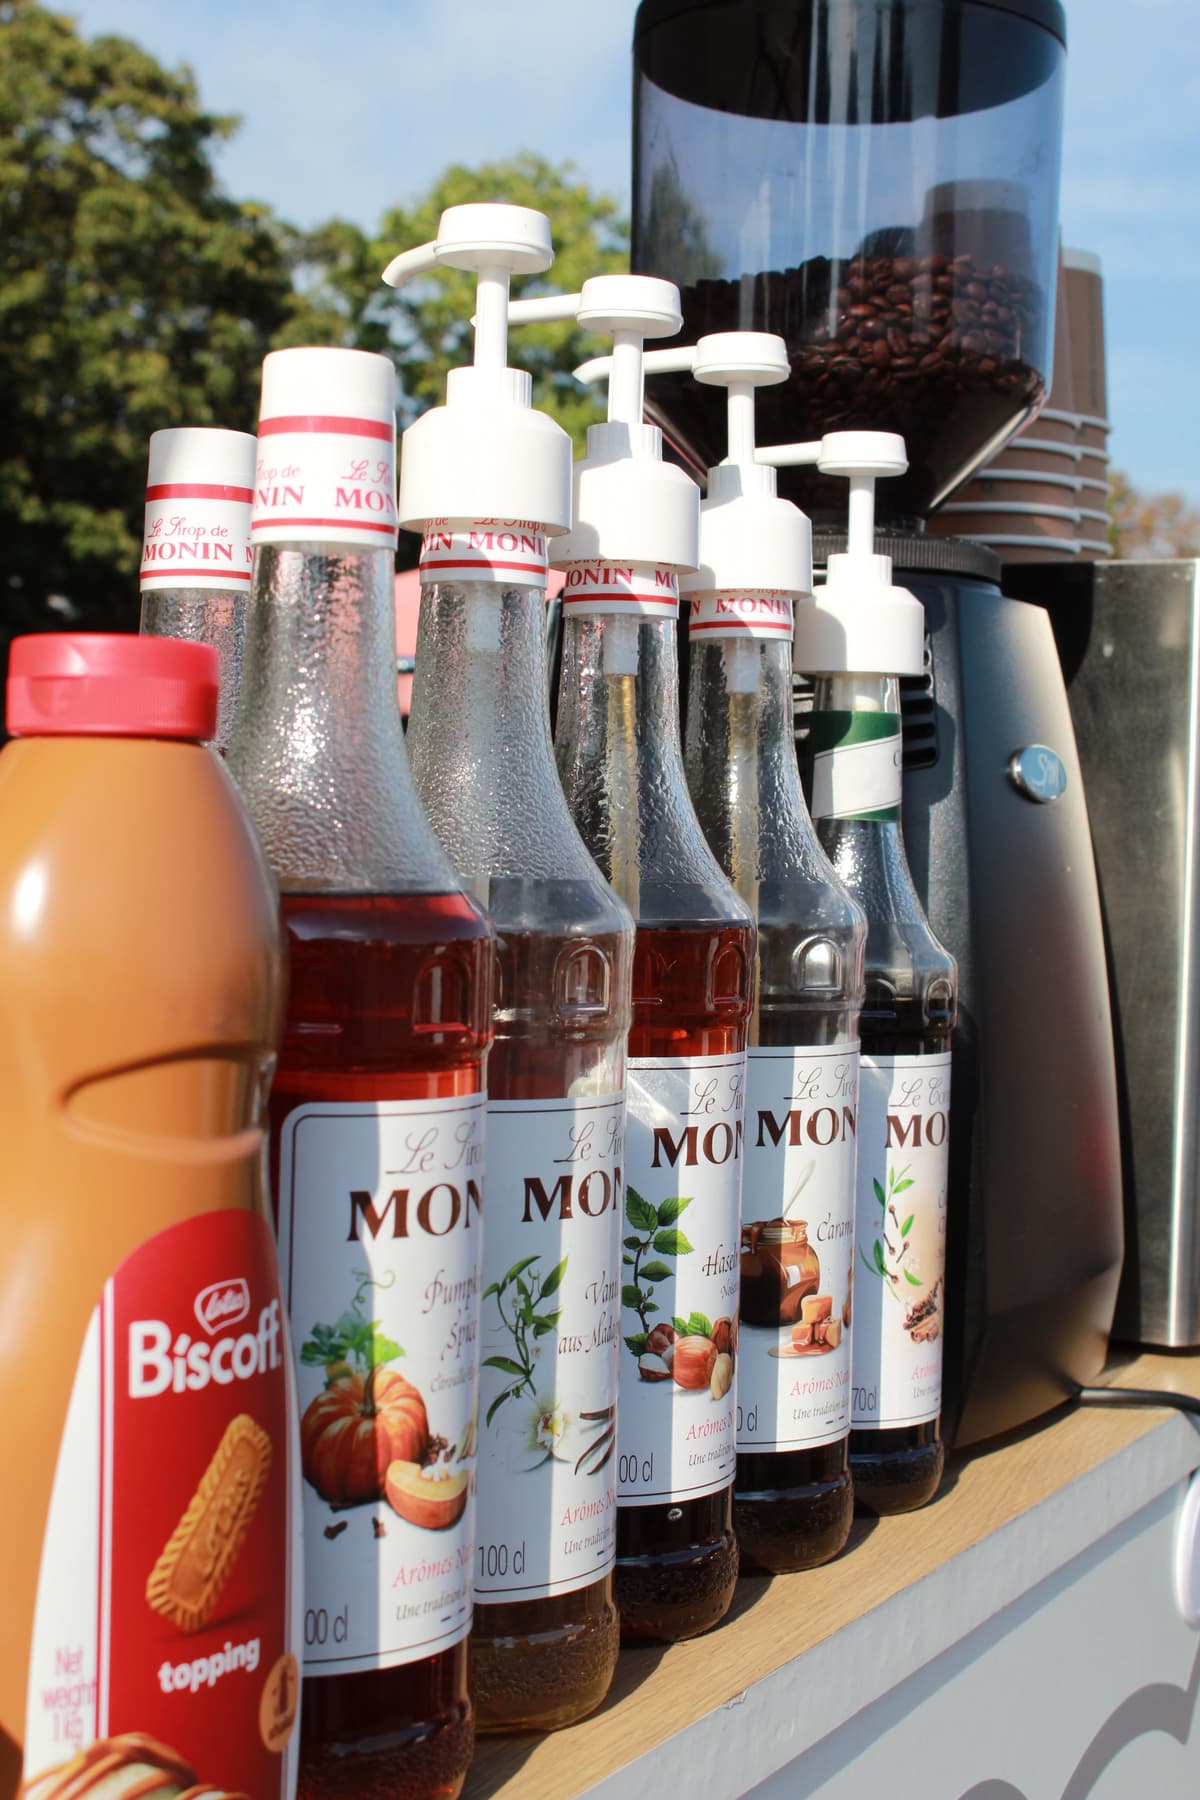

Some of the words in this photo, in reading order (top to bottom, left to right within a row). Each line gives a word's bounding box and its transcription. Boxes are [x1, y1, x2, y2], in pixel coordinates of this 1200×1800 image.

[341, 459, 369, 481] Le
[147, 518, 163, 538] Le
[165, 517, 206, 541] Sirop
[211, 525, 228, 537] de
[144, 542, 233, 562] MONIN
[680, 1078, 718, 1115] Le
[783, 1067, 822, 1100] Le
[889, 1078, 922, 1107] Le
[384, 1127, 439, 1174] Le
[552, 1121, 594, 1163] Le
[129, 1299, 280, 1399] Biscoff
[559, 1335, 583, 1354] aus
[789, 1376, 834, 1396] Arômes
[684, 1417, 727, 1440] Arômes
[747, 1404, 757, 1432] cl
[793, 1408, 812, 1421] Une
[642, 1452, 653, 1482] cl
[688, 1454, 706, 1466] Une
[560, 1498, 605, 1527] Arômes
[478, 1544, 508, 1577] 100
[513, 1540, 525, 1575] cl
[564, 1540, 583, 1555] Une
[391, 1556, 452, 1588] Arômes
[333, 1603, 348, 1644] cl
[395, 1603, 421, 1621] Une
[158, 1637, 261, 1693] topping
